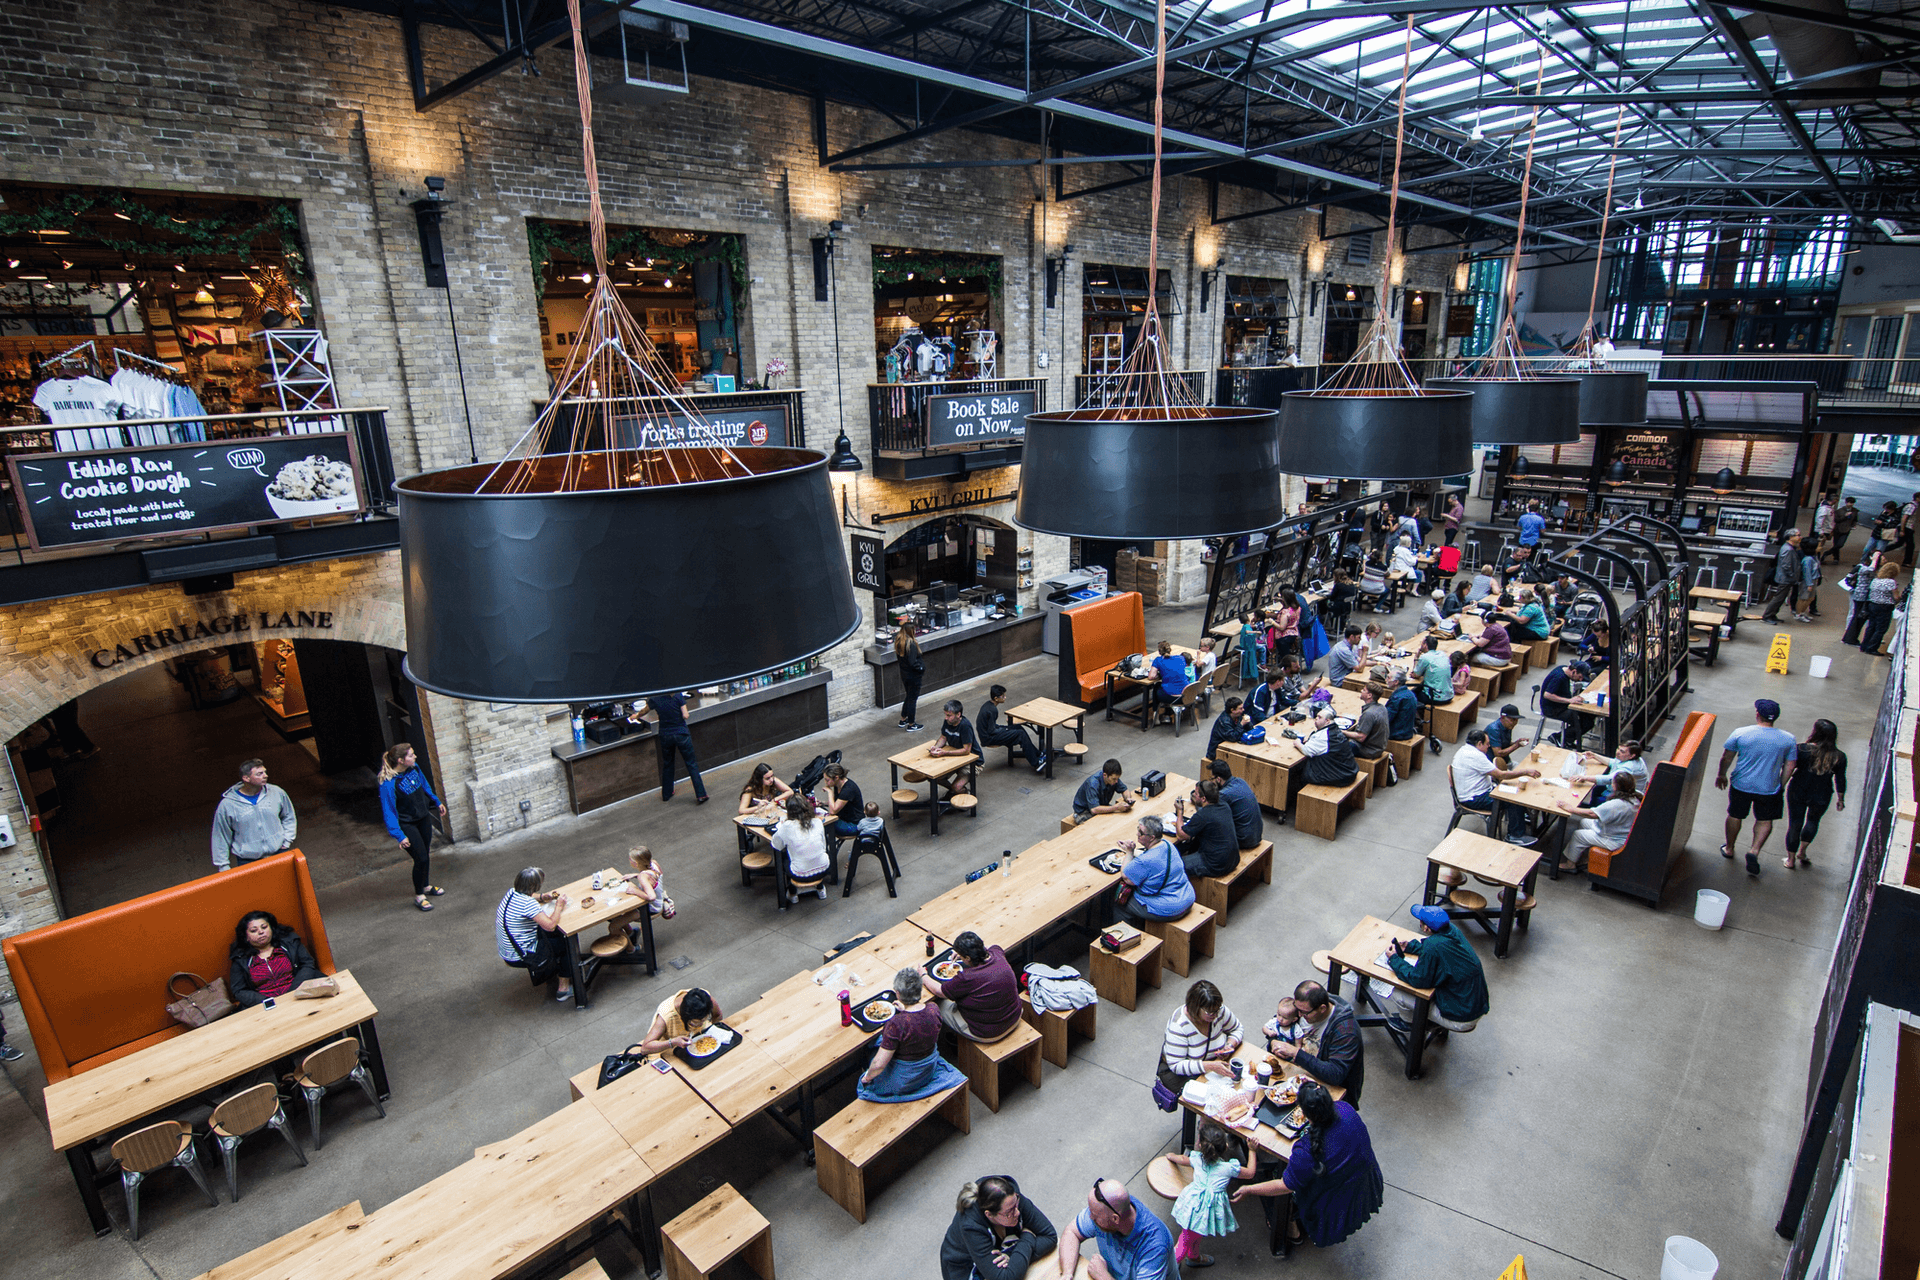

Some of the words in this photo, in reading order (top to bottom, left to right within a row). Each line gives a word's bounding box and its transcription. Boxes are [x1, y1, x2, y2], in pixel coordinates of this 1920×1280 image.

[946, 398, 987, 419] Book
[990, 397, 1020, 415] Sale
[637, 421, 685, 449] forks
[687, 420, 746, 438] trading
[955, 423, 974, 437] on
[978, 417, 1012, 434] Now
[1626, 434, 1668, 443] common
[67, 458, 128, 480] Edible
[130, 457, 173, 474] Raw
[230, 450, 262, 467] YUM!
[1620, 454, 1667, 466] Canada
[60, 479, 129, 500] Cookie
[130, 472, 191, 494] Dough
[76, 507, 111, 519] Locally
[112, 504, 139, 514] made
[140, 502, 161, 512] with
[161, 499, 186, 510] heat
[910, 494, 946, 512] KYU
[952, 487, 993, 507] GRILL
[70, 518, 112, 530] treated
[114, 516, 140, 526] flour
[140, 513, 160, 522] and
[174, 510, 196, 520] eggs
[859, 541, 875, 554] KYU
[857, 572, 880, 587] GRILL
[91, 614, 250, 669] CARRIAGE
[258, 610, 333, 629] LANE
